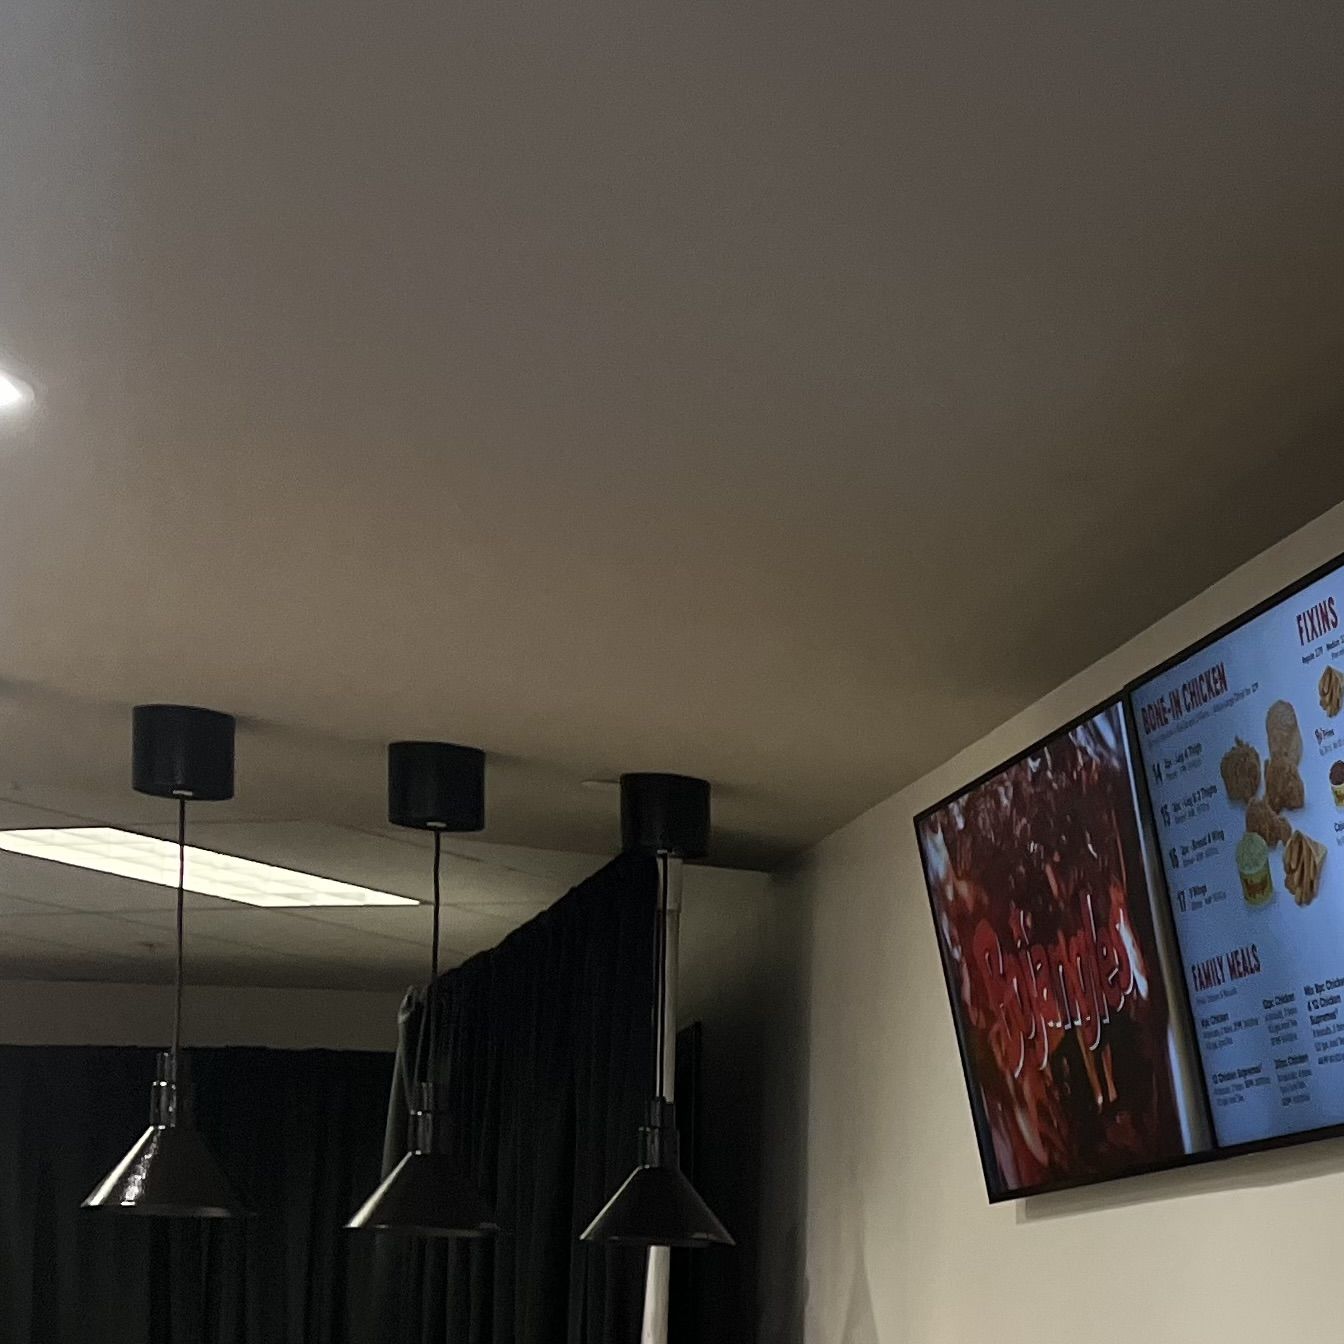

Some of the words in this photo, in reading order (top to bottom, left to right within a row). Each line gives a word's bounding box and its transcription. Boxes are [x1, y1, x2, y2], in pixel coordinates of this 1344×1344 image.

[1297, 597, 1338, 645] FIXINS
[1142, 688, 1182, 736] BONE-IN
[1183, 662, 1228, 711] CHICKEN
[1192, 953, 1227, 991] FAMILY
[1228, 945, 1261, 981] MEALS
